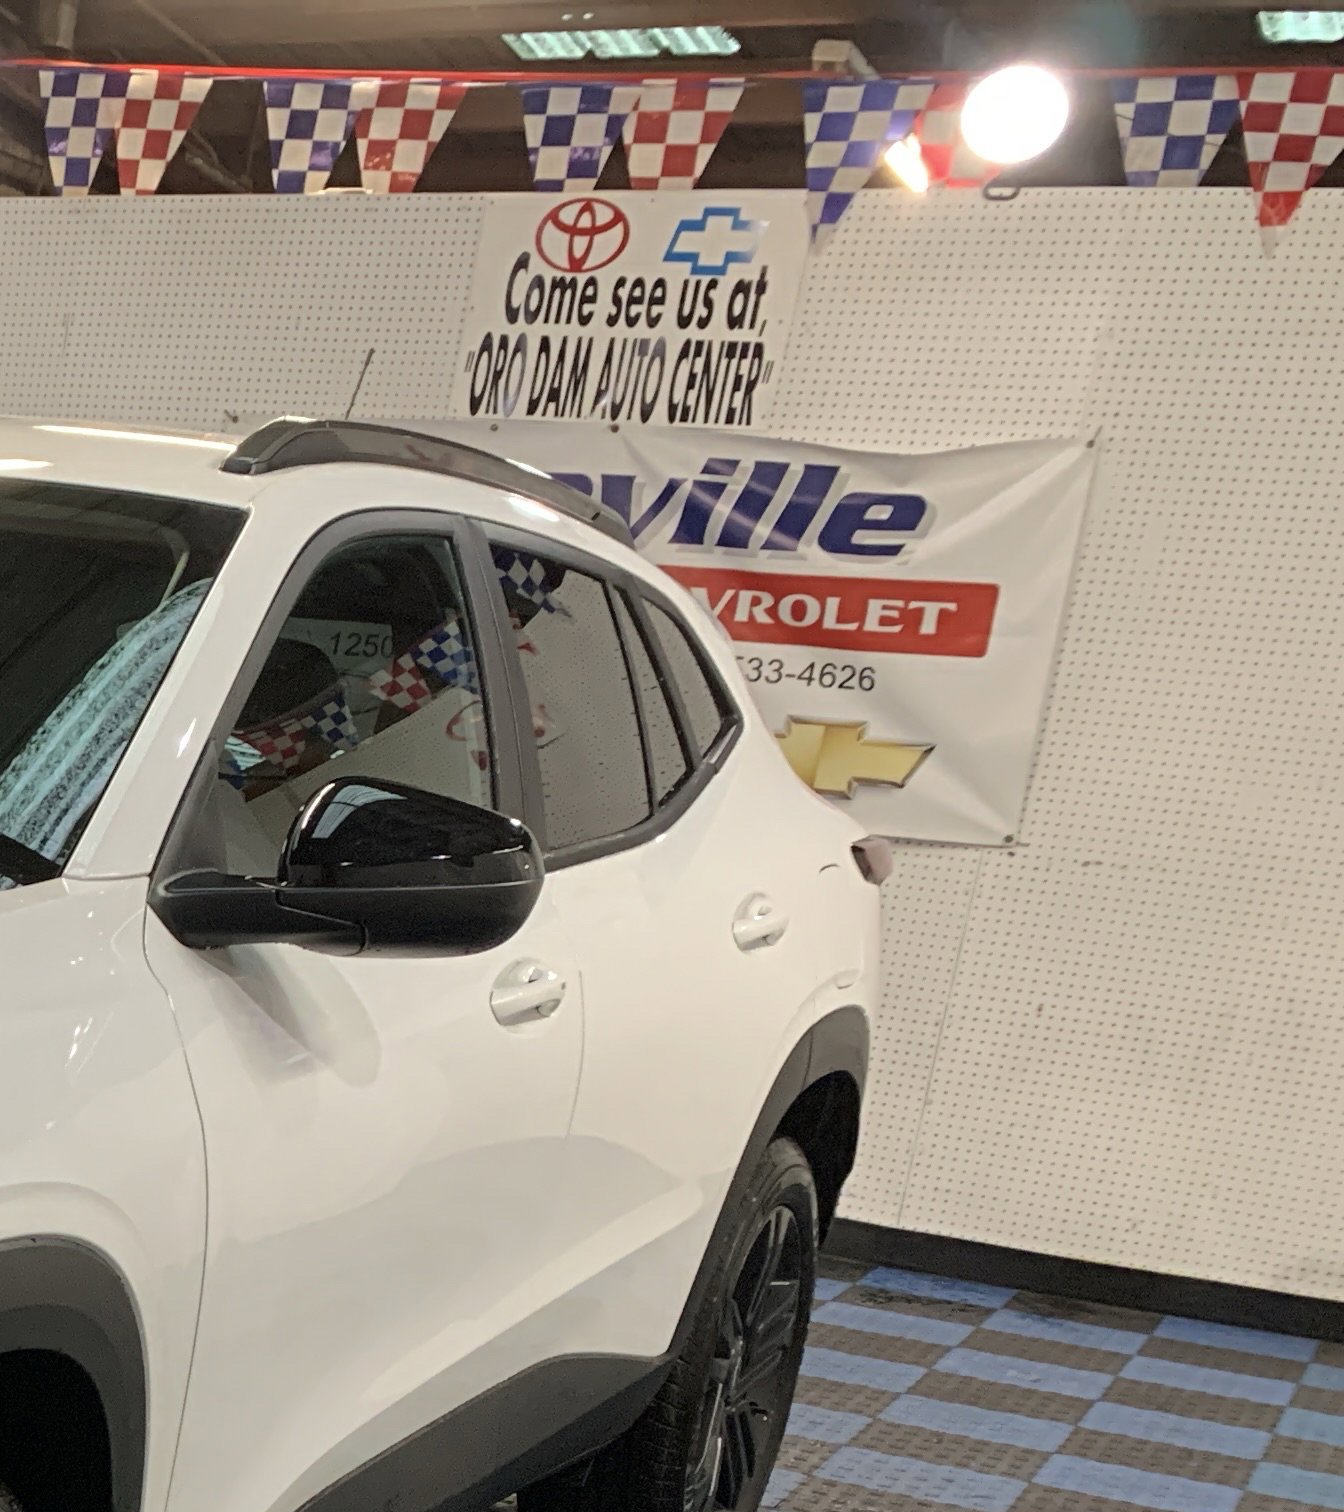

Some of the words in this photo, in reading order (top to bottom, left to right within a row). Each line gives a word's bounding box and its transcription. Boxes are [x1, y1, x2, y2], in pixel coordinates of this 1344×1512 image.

[504, 251, 600, 327] Come
[606, 275, 667, 329] see
[676, 276, 719, 330] us
[726, 265, 769, 338] at,
[525, 335, 594, 419] DAM
[587, 335, 667, 424] AUTO
[666, 337, 775, 426] CENTER"
[547, 457, 928, 558] ville
[330, 631, 394, 659] 1250
